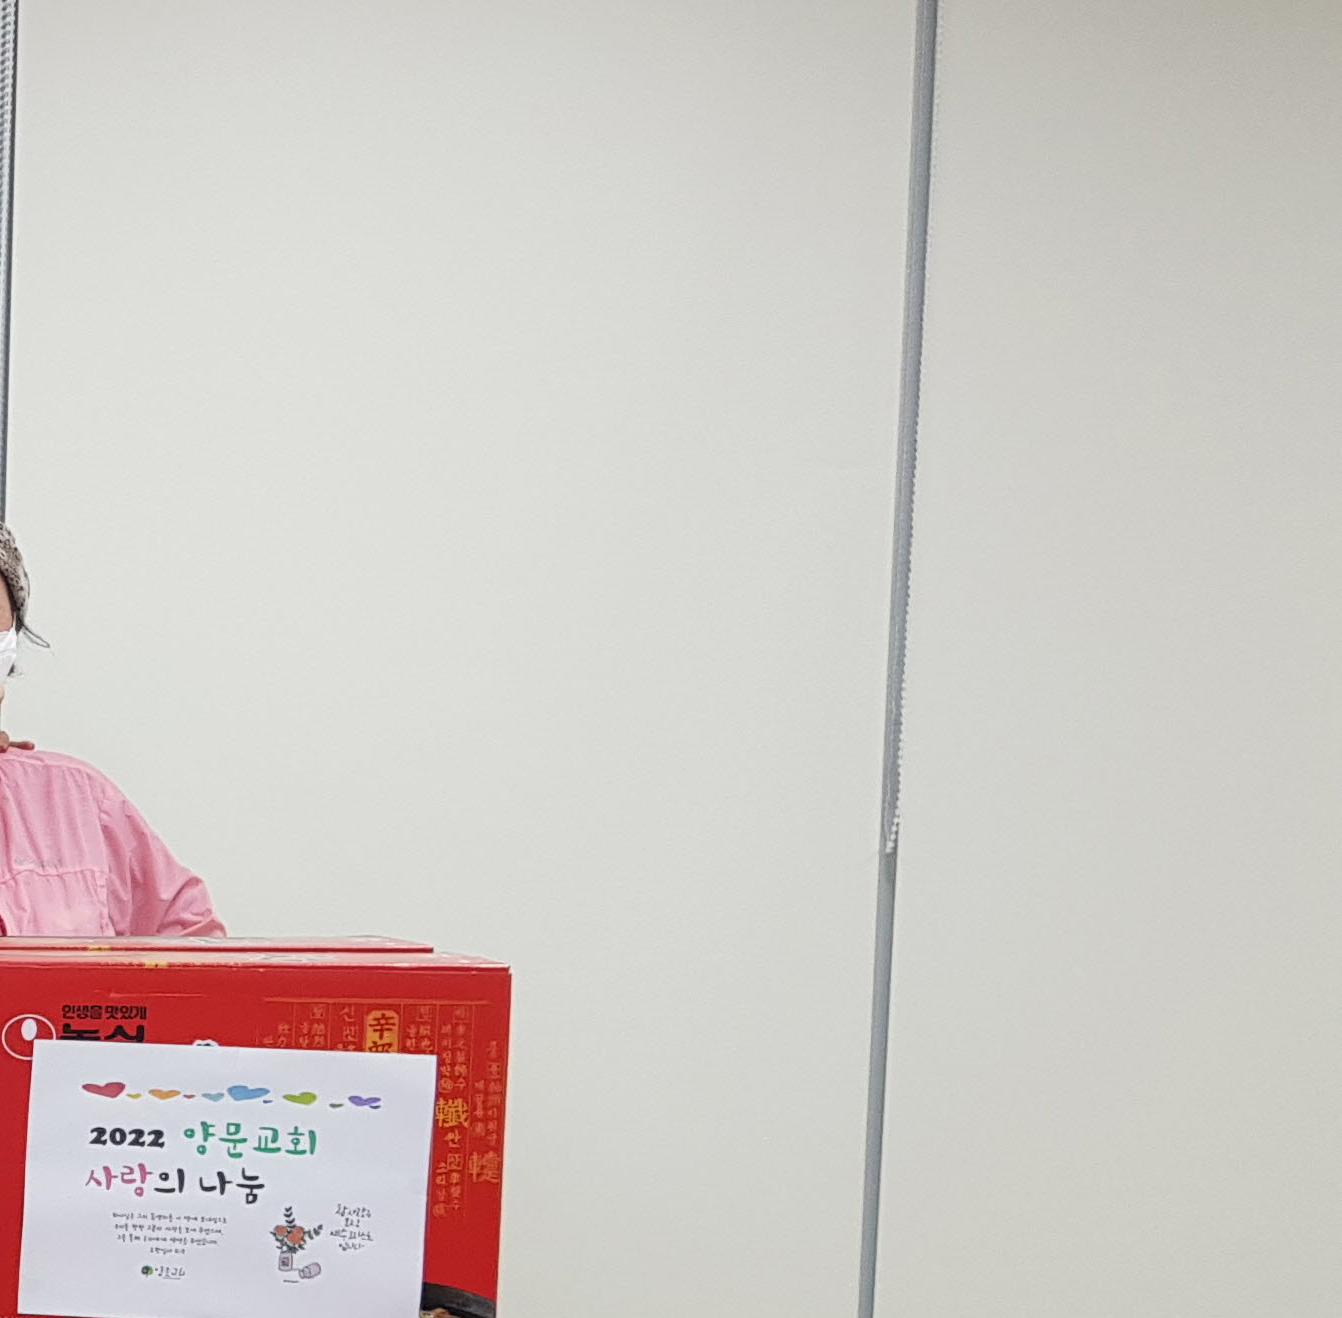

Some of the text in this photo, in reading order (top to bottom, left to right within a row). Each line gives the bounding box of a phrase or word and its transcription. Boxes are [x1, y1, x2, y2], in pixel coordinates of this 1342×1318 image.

[89, 1120, 317, 1159] 2022 양문교회
[85, 1162, 265, 1205] 사랑의 나눔
